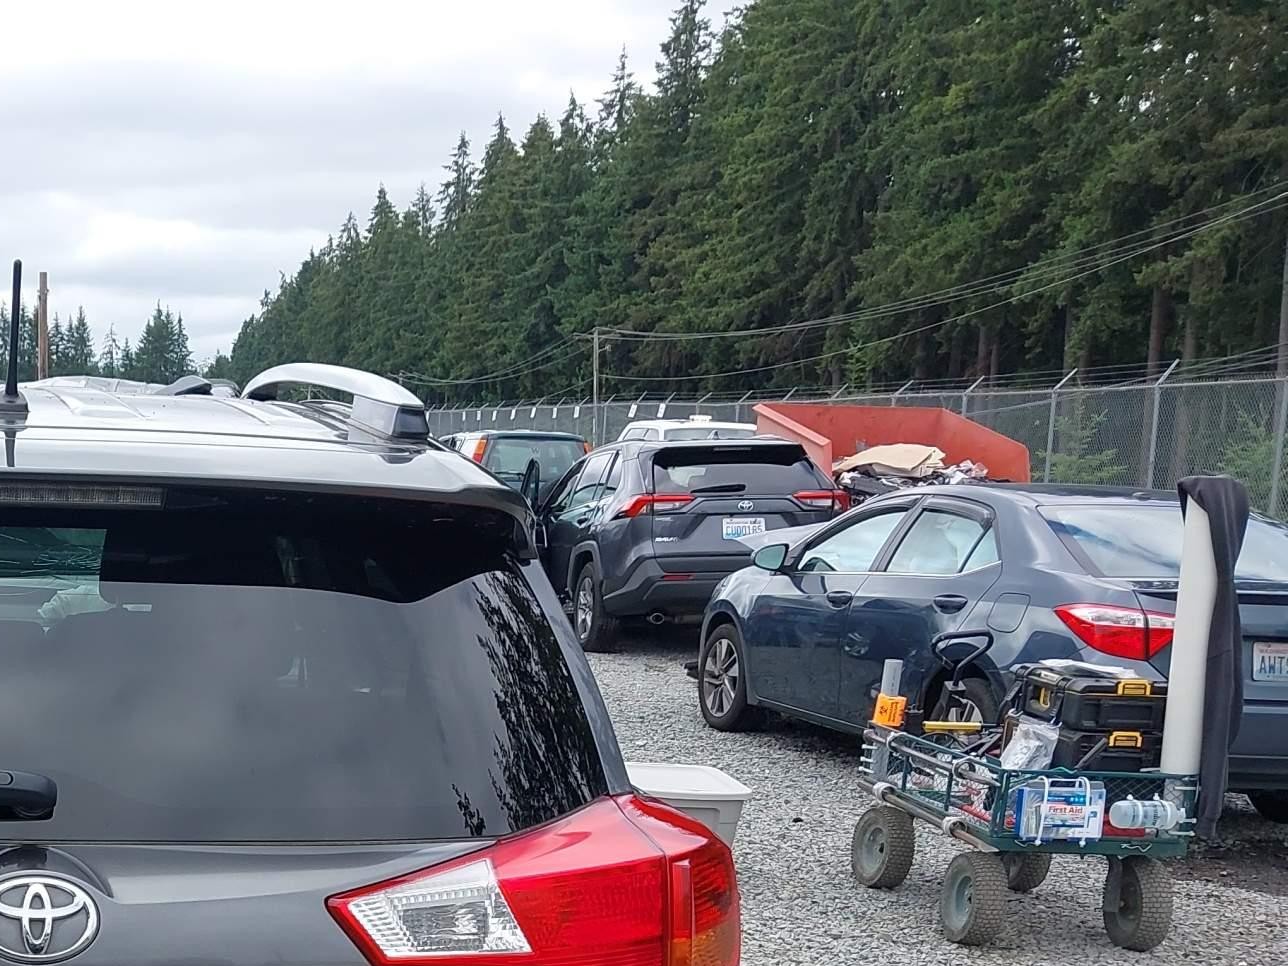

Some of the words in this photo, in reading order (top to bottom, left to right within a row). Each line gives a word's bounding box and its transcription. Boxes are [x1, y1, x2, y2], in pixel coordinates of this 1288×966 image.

[1259, 655, 1288, 675] AWT
[1048, 805, 1067, 814] First
[1069, 805, 1083, 814] Aid
